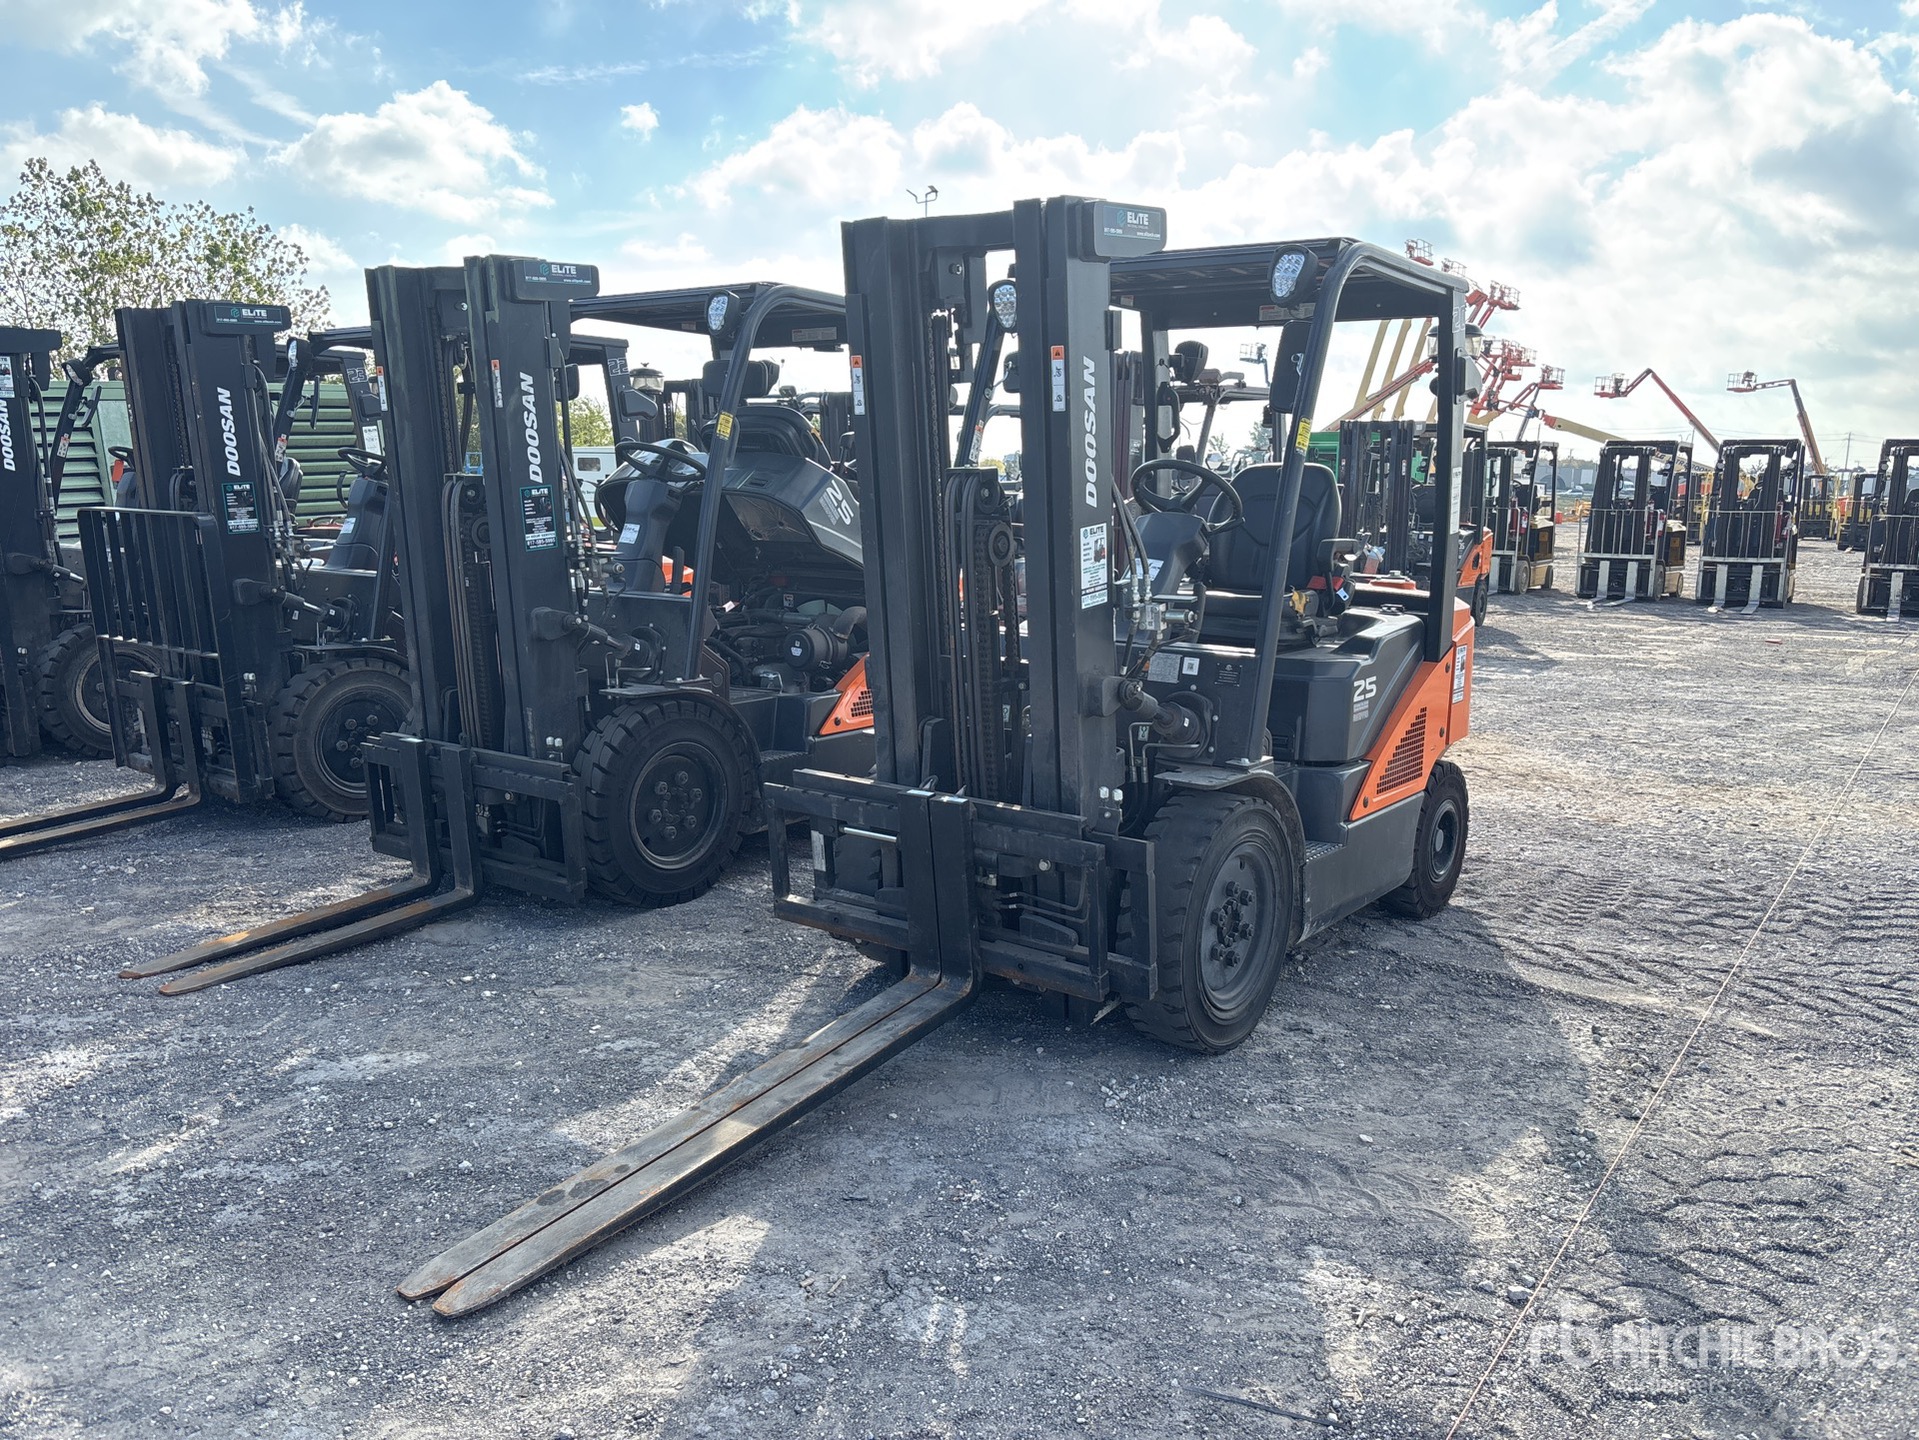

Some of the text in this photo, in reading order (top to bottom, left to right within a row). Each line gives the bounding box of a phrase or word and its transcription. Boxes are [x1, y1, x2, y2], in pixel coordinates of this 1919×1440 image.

[1127, 211, 1149, 225] ELITE
[551, 264, 577, 275] ELITE
[241, 308, 268, 317] ELITE
[347, 367, 368, 384] 23
[608, 357, 630, 376] 22
[0, 399, 16, 472] DOOSAN
[216, 386, 241, 477] DOOSAN
[519, 371, 543, 484] DOOSAN
[1083, 355, 1098, 508] DOOSAN
[826, 479, 854, 525] 25
[1089, 525, 1104, 535] ELITE
[1353, 675, 1377, 702] 25
